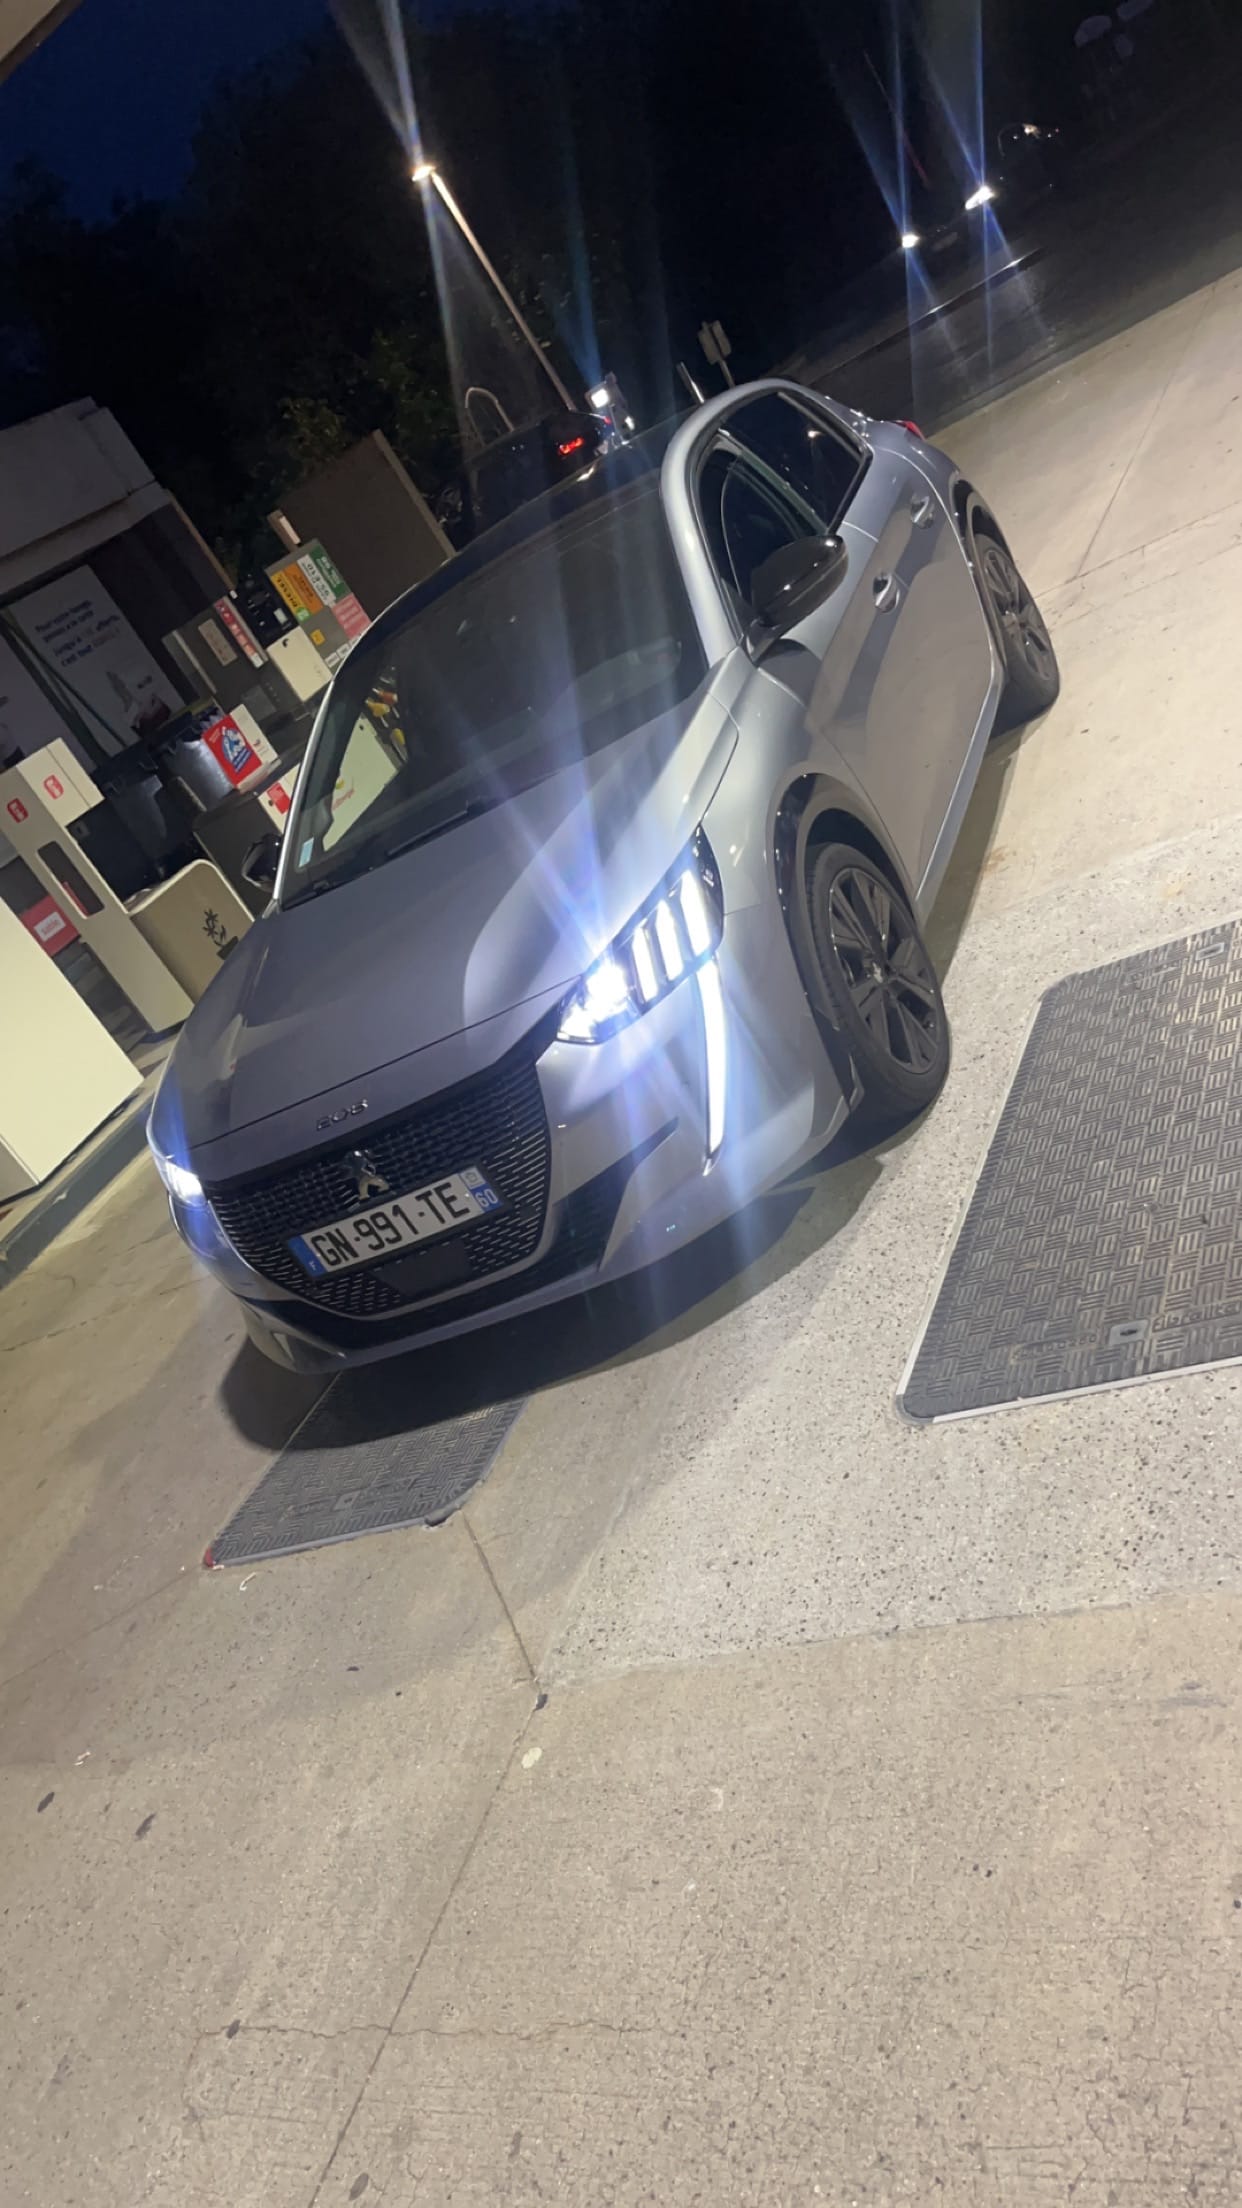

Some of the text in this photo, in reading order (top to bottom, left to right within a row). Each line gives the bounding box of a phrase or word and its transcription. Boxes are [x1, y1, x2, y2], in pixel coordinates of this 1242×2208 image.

[276, 577, 298, 607] DIESEL
[311, 1182, 470, 1267] GN-991-TE
[474, 1189, 498, 1208] 60
